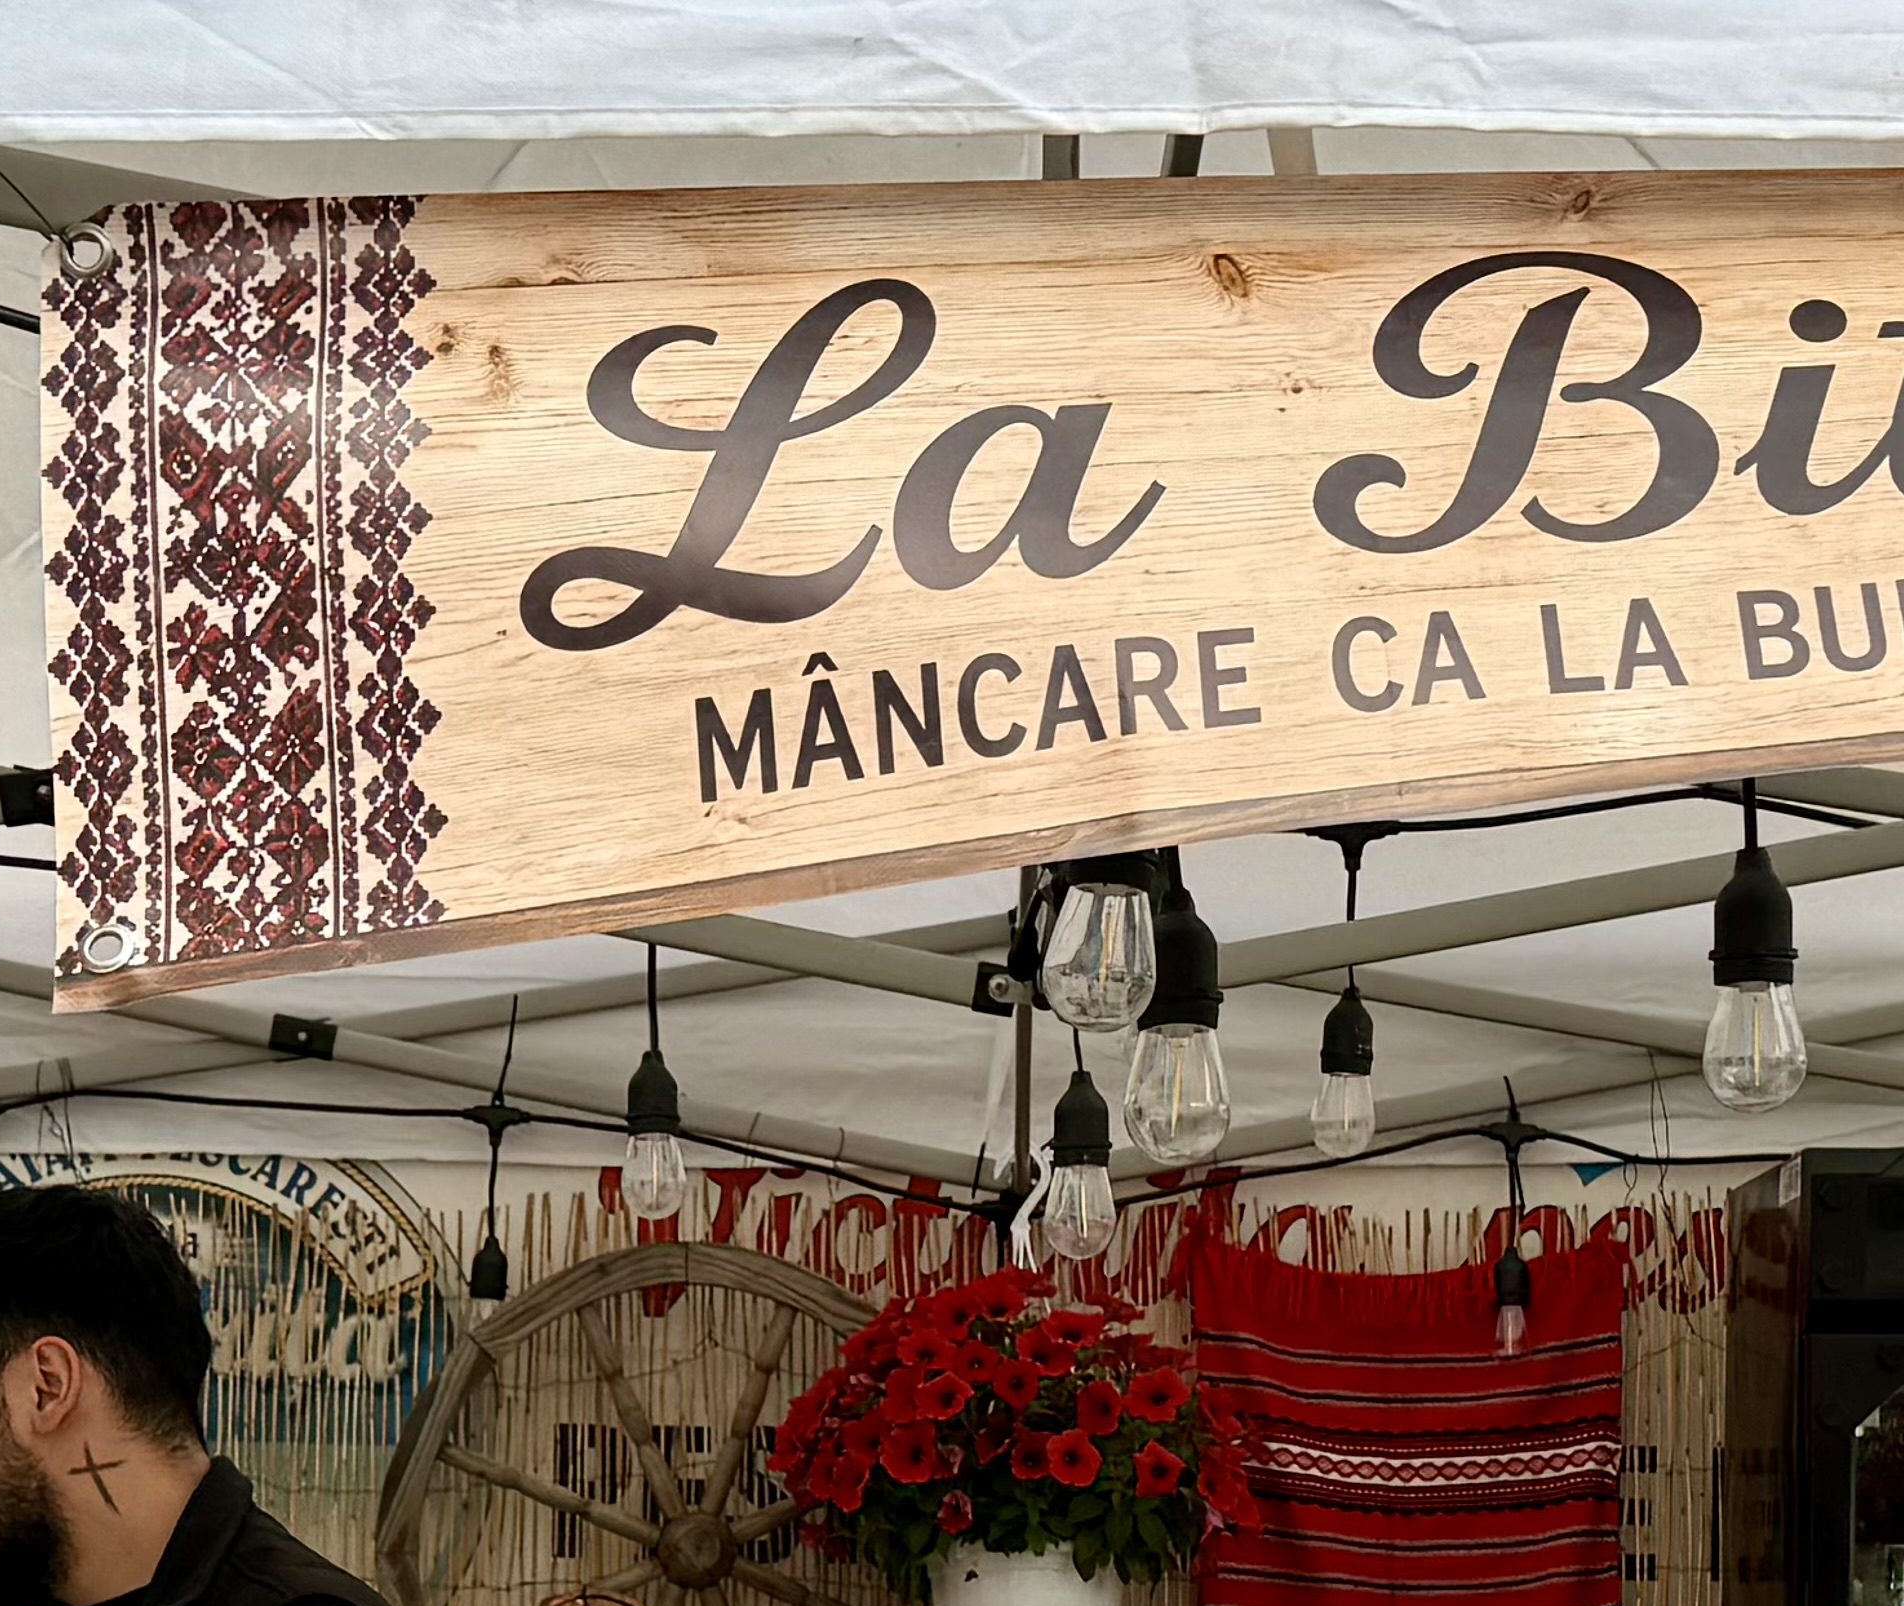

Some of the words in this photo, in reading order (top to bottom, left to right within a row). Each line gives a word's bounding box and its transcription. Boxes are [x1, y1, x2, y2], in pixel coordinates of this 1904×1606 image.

[519, 278, 1167, 651] La
[695, 651, 1262, 803] MÂNCARE
[1331, 610, 1486, 714] CA
[1540, 597, 1688, 695] LA
